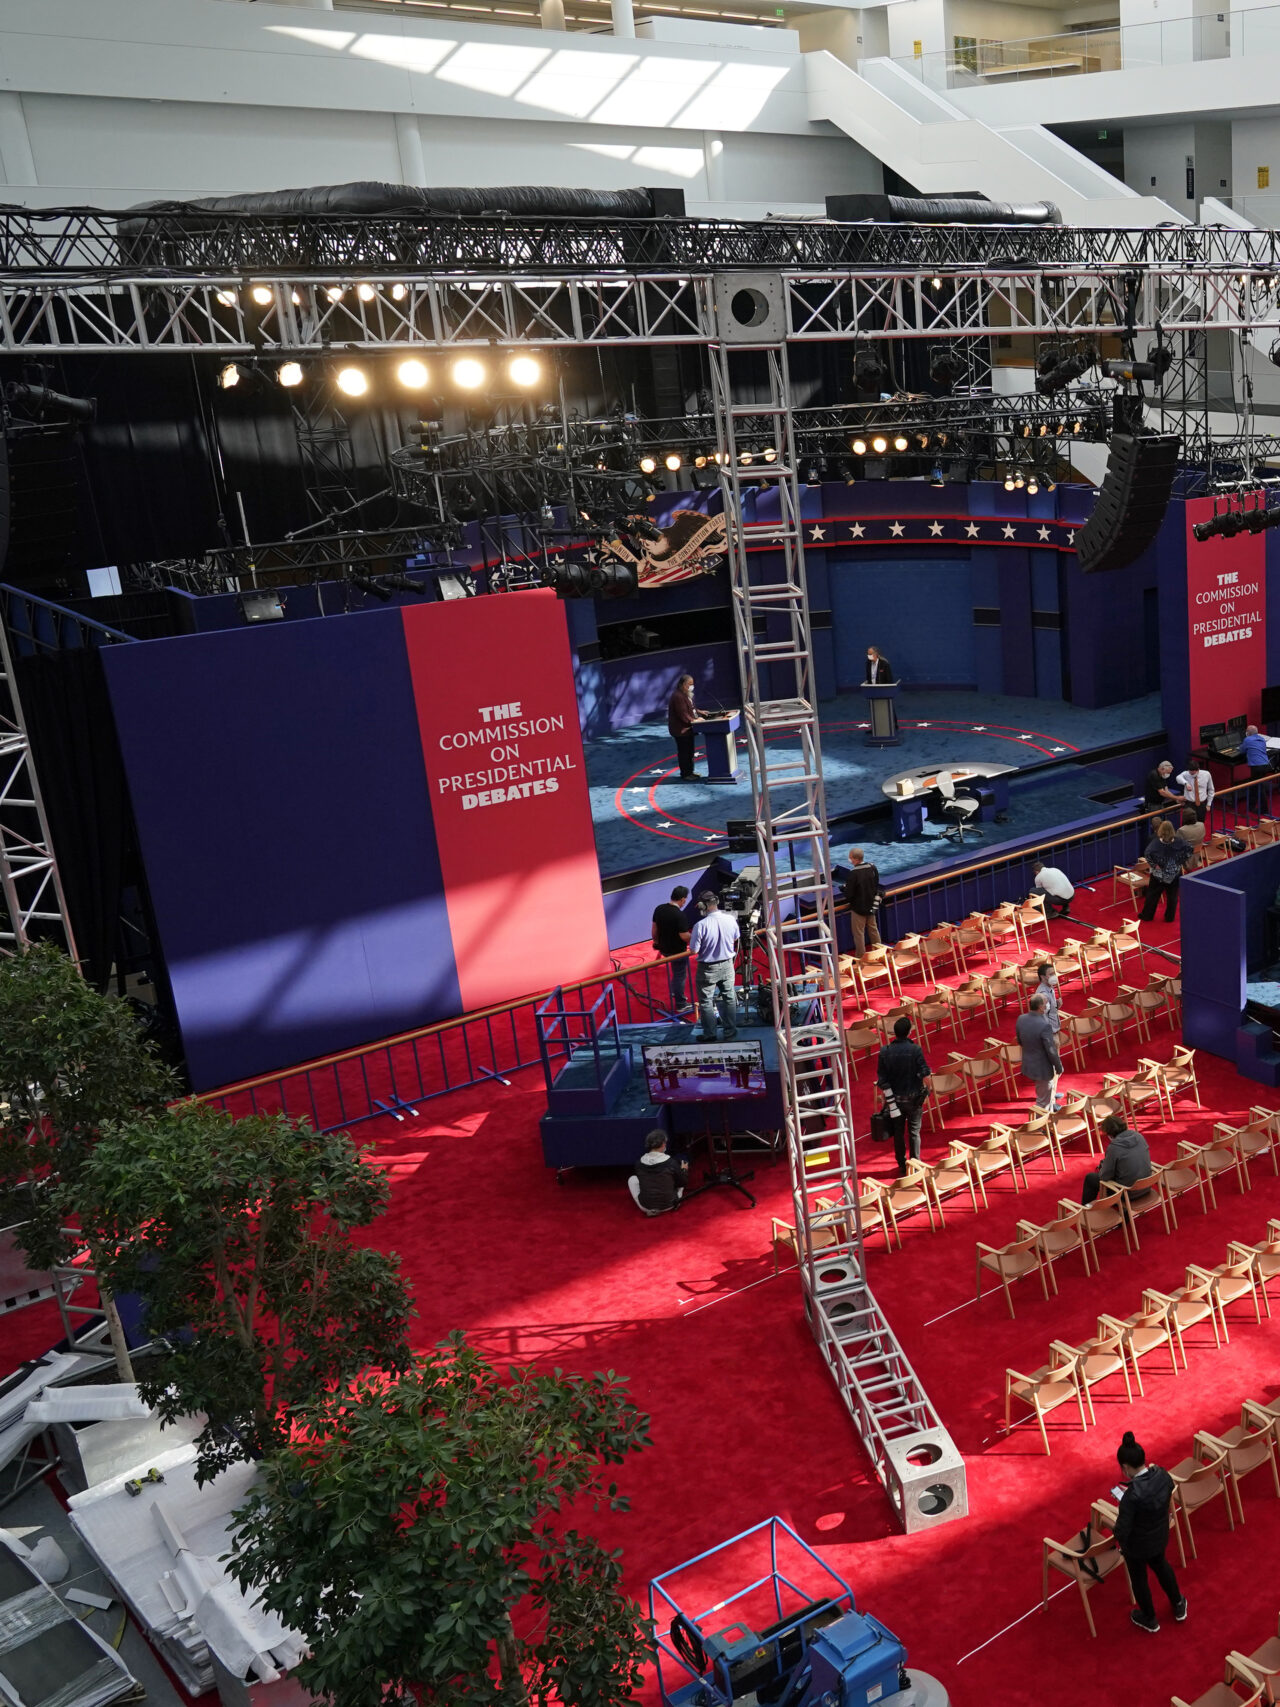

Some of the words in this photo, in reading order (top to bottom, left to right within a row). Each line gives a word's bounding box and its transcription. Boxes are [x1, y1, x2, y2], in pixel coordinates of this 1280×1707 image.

[679, 528, 709, 560] CONSTITUTION
[1217, 571, 1239, 586] THE
[1195, 582, 1259, 605] COMMISSION
[1219, 601, 1235, 615] ON
[1193, 610, 1262, 635] PRESIDENTIAL
[1204, 627, 1253, 648] DEBATES
[478, 701, 523, 723] THE
[439, 714, 565, 751] COMMISSION
[490, 743, 520, 763] ON
[438, 754, 577, 794] PRESIDENTIAL
[462, 777, 560, 811] DEBATES
